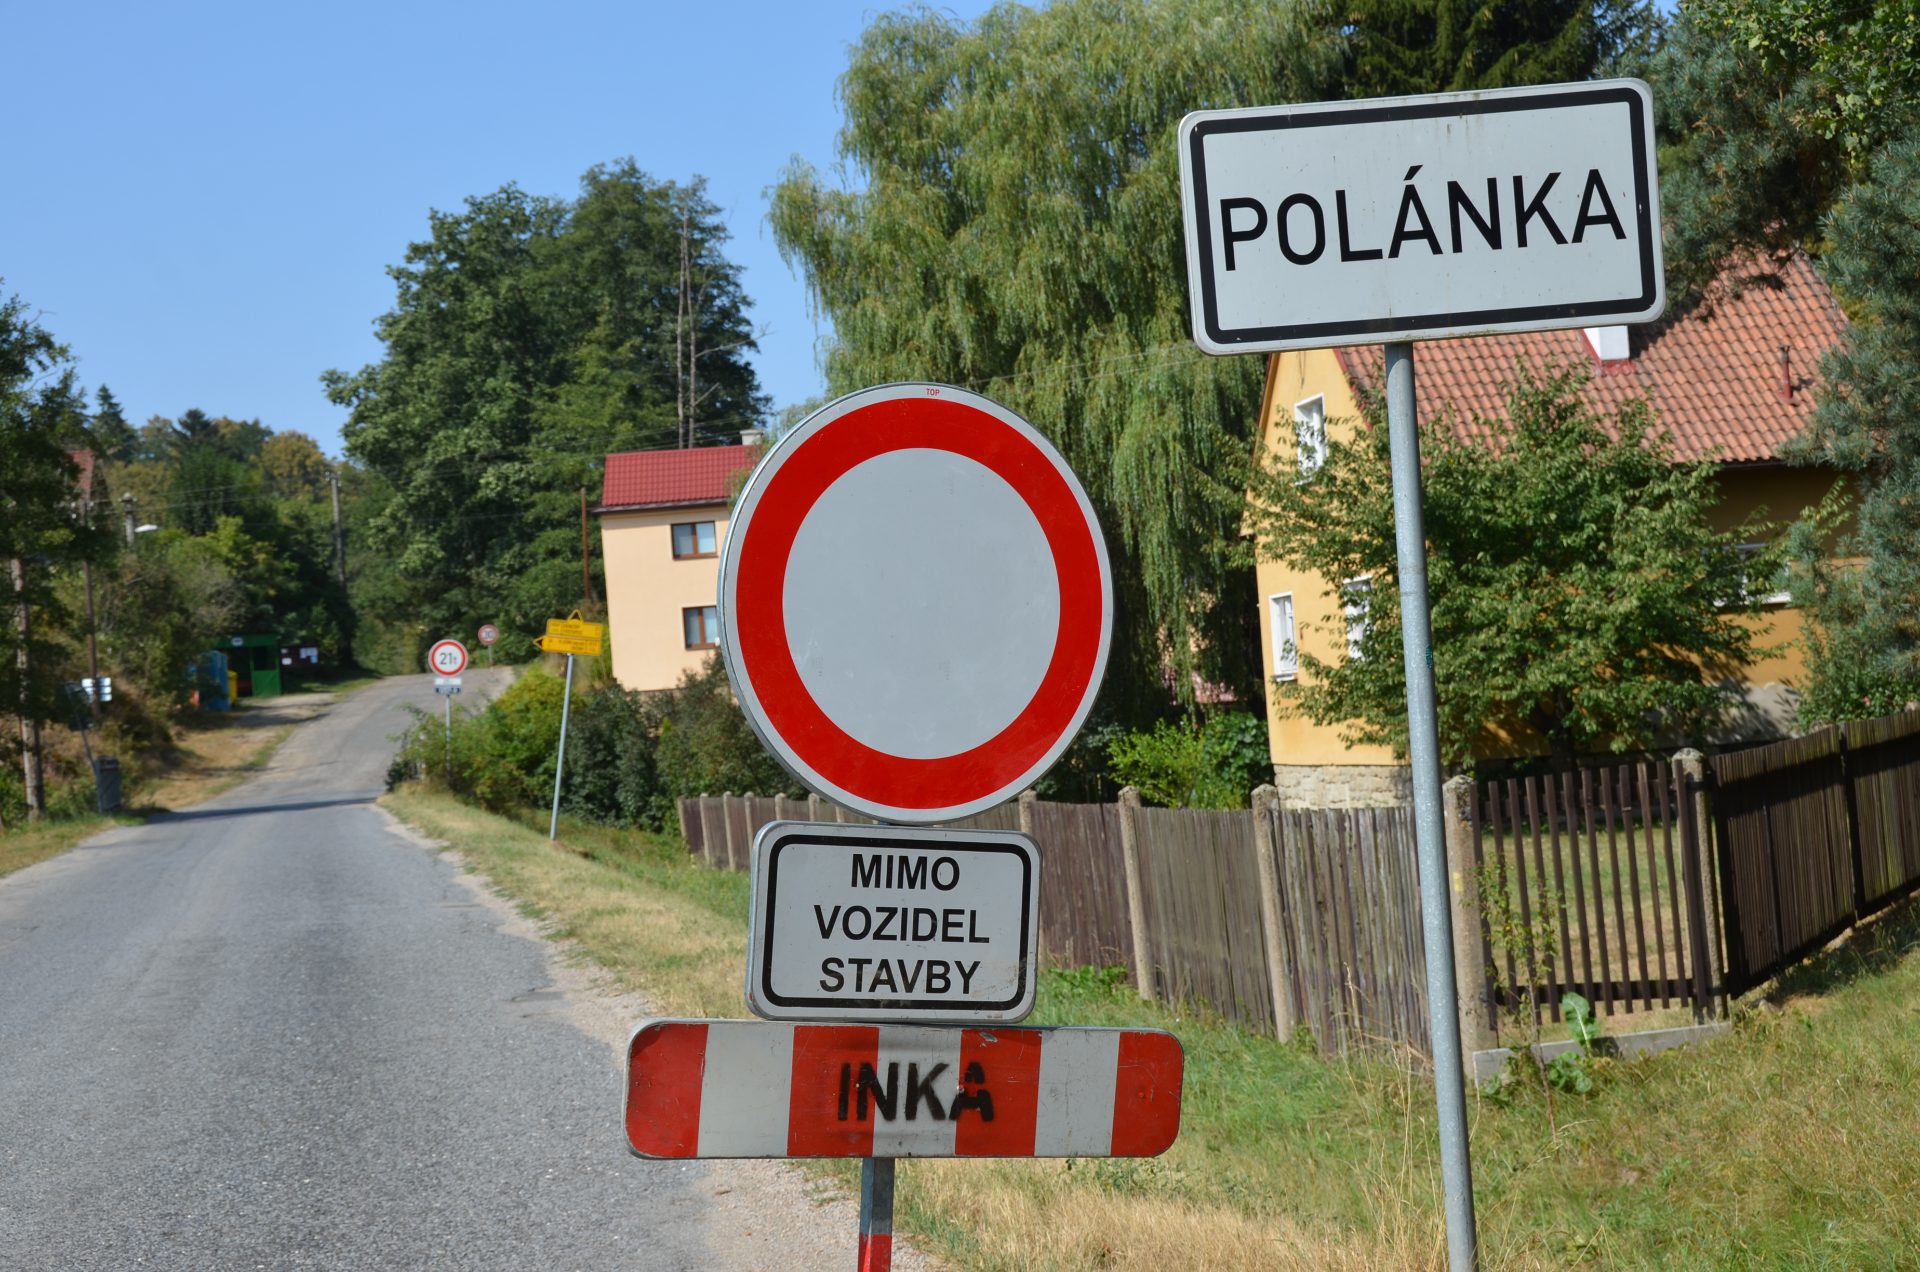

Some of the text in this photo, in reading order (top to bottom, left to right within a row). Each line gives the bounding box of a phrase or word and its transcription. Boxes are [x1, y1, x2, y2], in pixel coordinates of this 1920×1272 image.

[1220, 164, 1626, 271] POLÁNKA
[926, 388, 940, 396] TOP
[851, 854, 960, 891] MIMO
[814, 904, 990, 943] VOZIDEL
[819, 957, 981, 994] STAVBY
[838, 1062, 994, 1122] INKA
